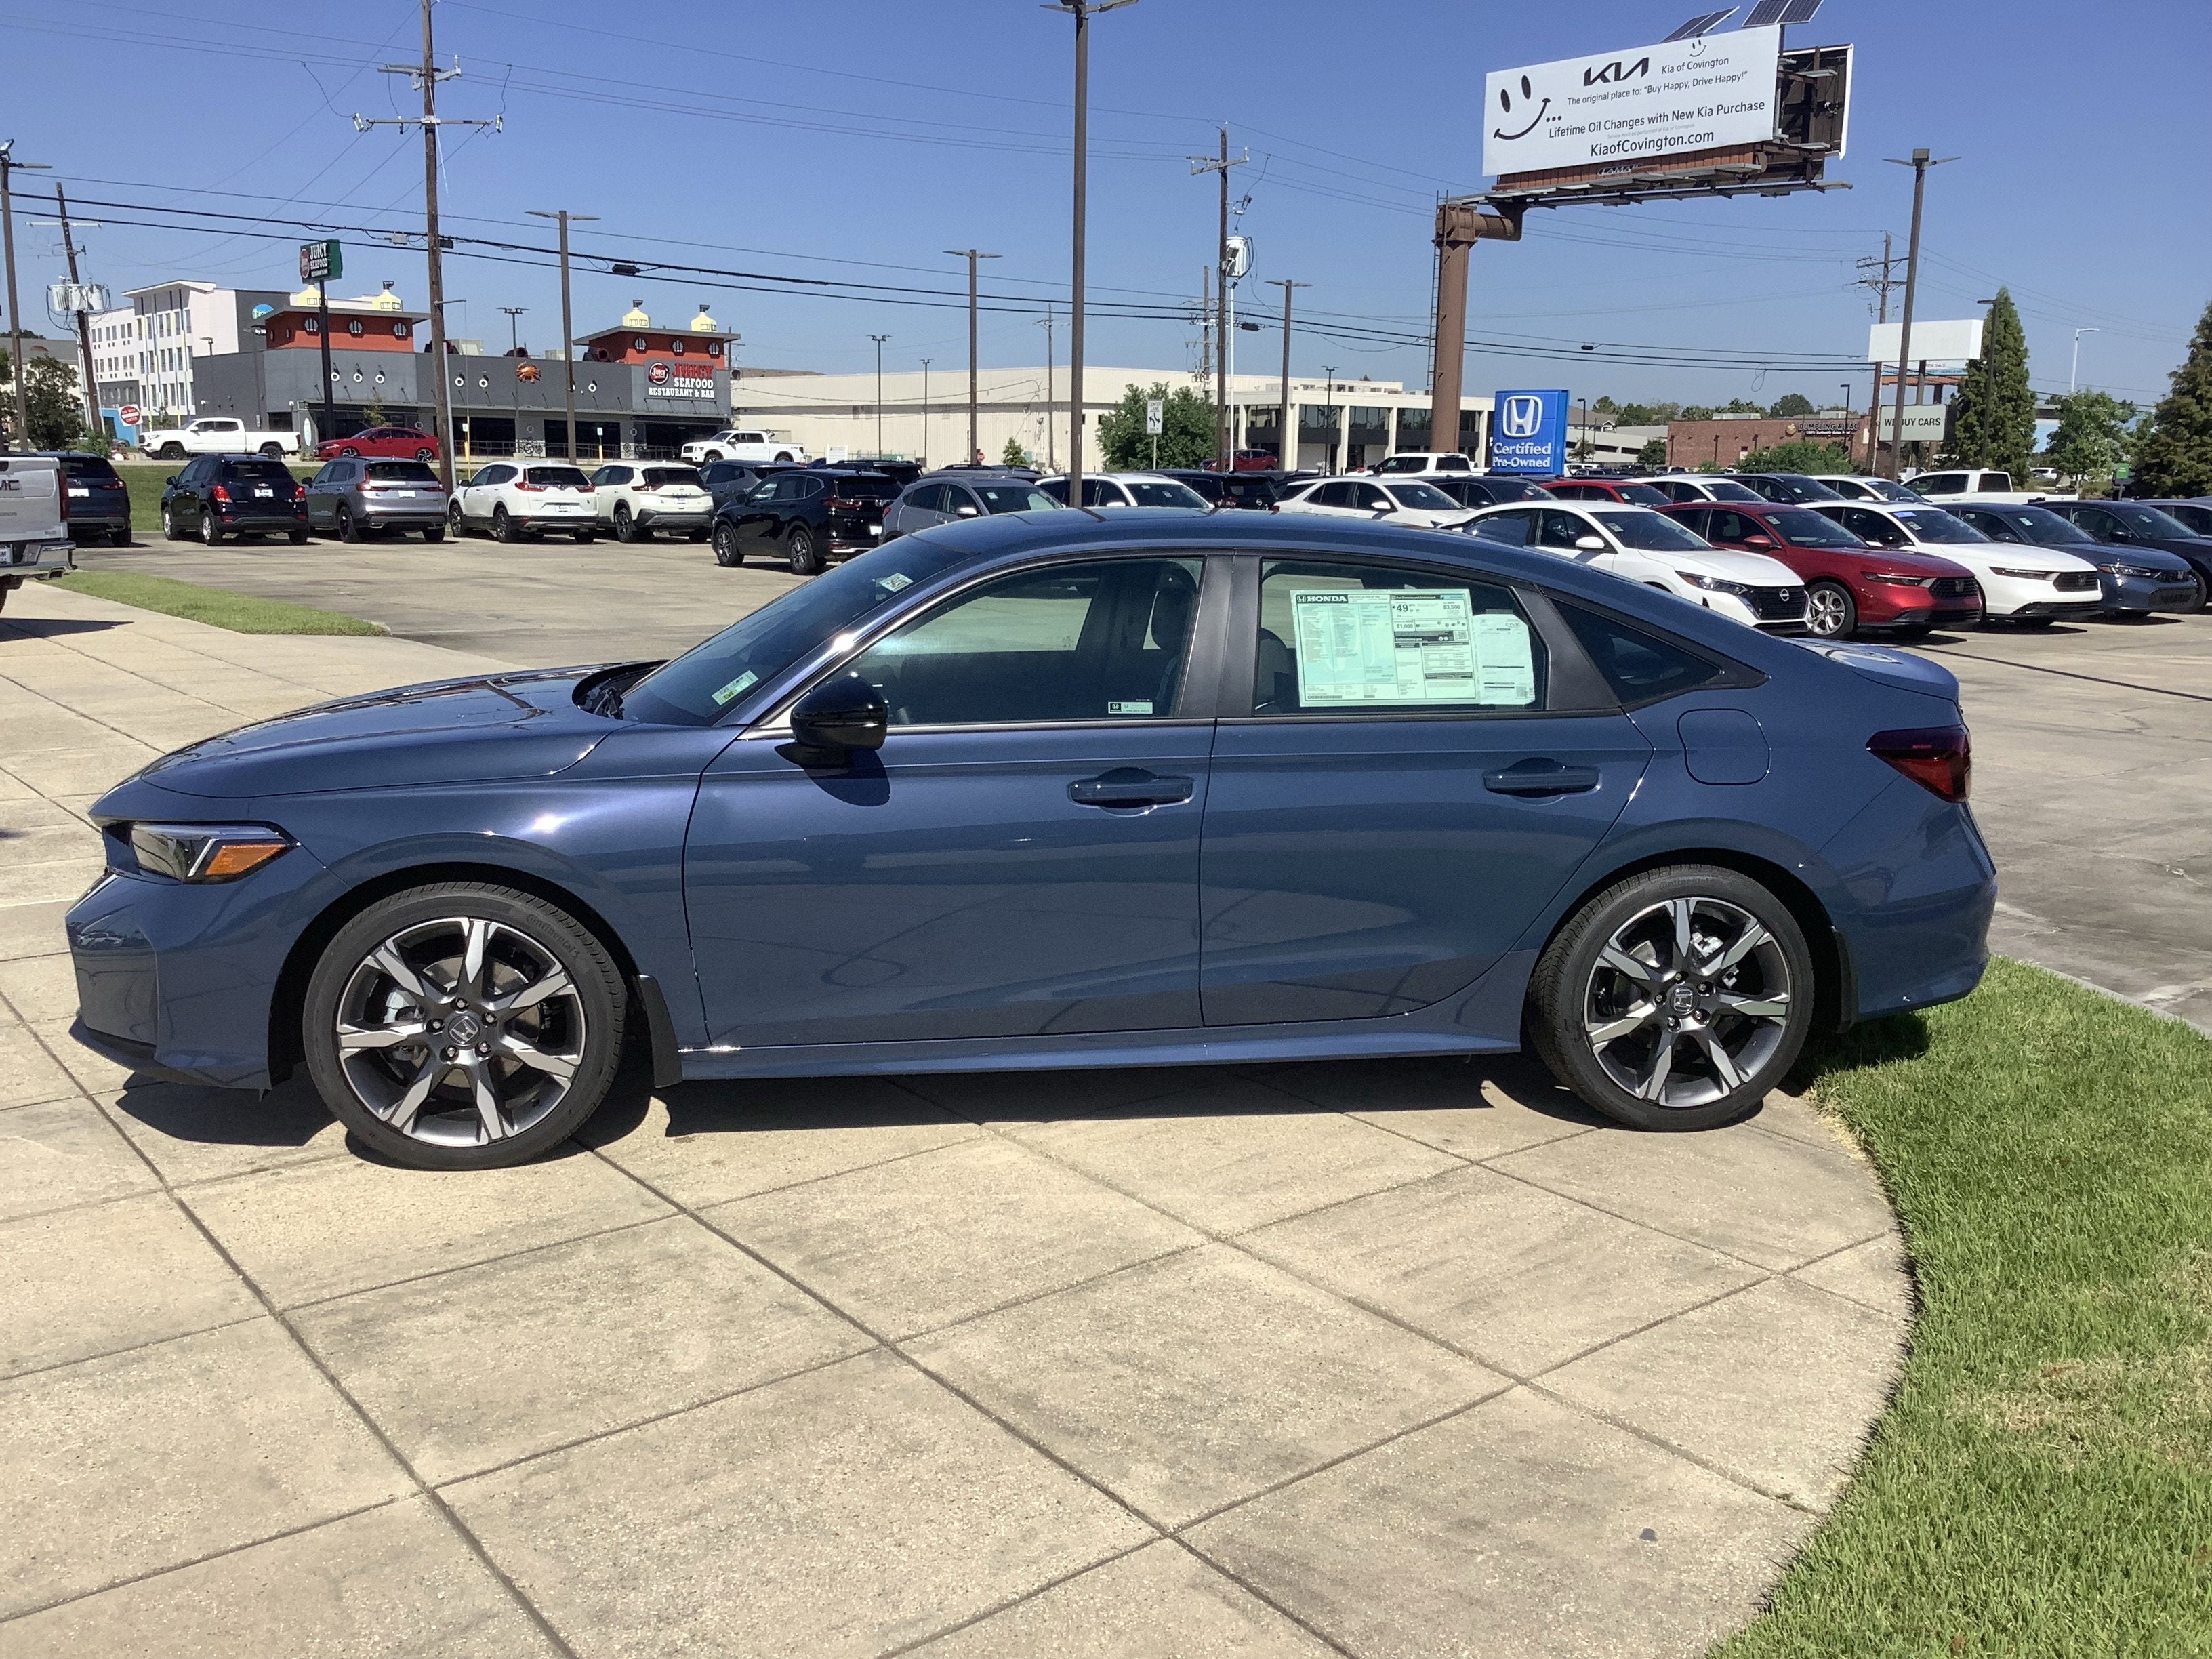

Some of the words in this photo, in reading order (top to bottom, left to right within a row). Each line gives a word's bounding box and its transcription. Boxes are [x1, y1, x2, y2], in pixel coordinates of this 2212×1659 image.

[1584, 57, 1649, 86] KIA
[1662, 65, 1675, 75] Kia
[1677, 63, 1685, 73] of
[1687, 57, 1729, 70] Covington
[1568, 97, 1580, 106] The
[1582, 91, 1609, 105] original
[1611, 89, 1630, 102] place
[1632, 88, 1642, 96] to:
[1663, 81, 1690, 93] Happy,
[1693, 77, 1713, 87] Drive
[1549, 124, 1585, 138] Lifetime
[1589, 120, 1601, 132] Oil
[1603, 116, 1645, 131] Changes
[1647, 113, 1668, 126] with
[1671, 109, 1694, 121] New
[1697, 106, 1713, 118] Kia
[1716, 101, 1765, 115] Purchase
[1591, 131, 1714, 157] KiaofCovington.com
[310, 243, 327, 260] JUICY
[674, 377, 714, 389] SEAFOOD
[649, 387, 693, 397] RESTAURANT
[701, 390, 715, 398] BAR
[1798, 423, 1836, 431] DUMPLING
[1918, 418, 1941, 426] CARS
[1493, 442, 1551, 455] Certified
[1492, 457, 1551, 468] Pre-Owned
[1396, 604, 1408, 612] 49
